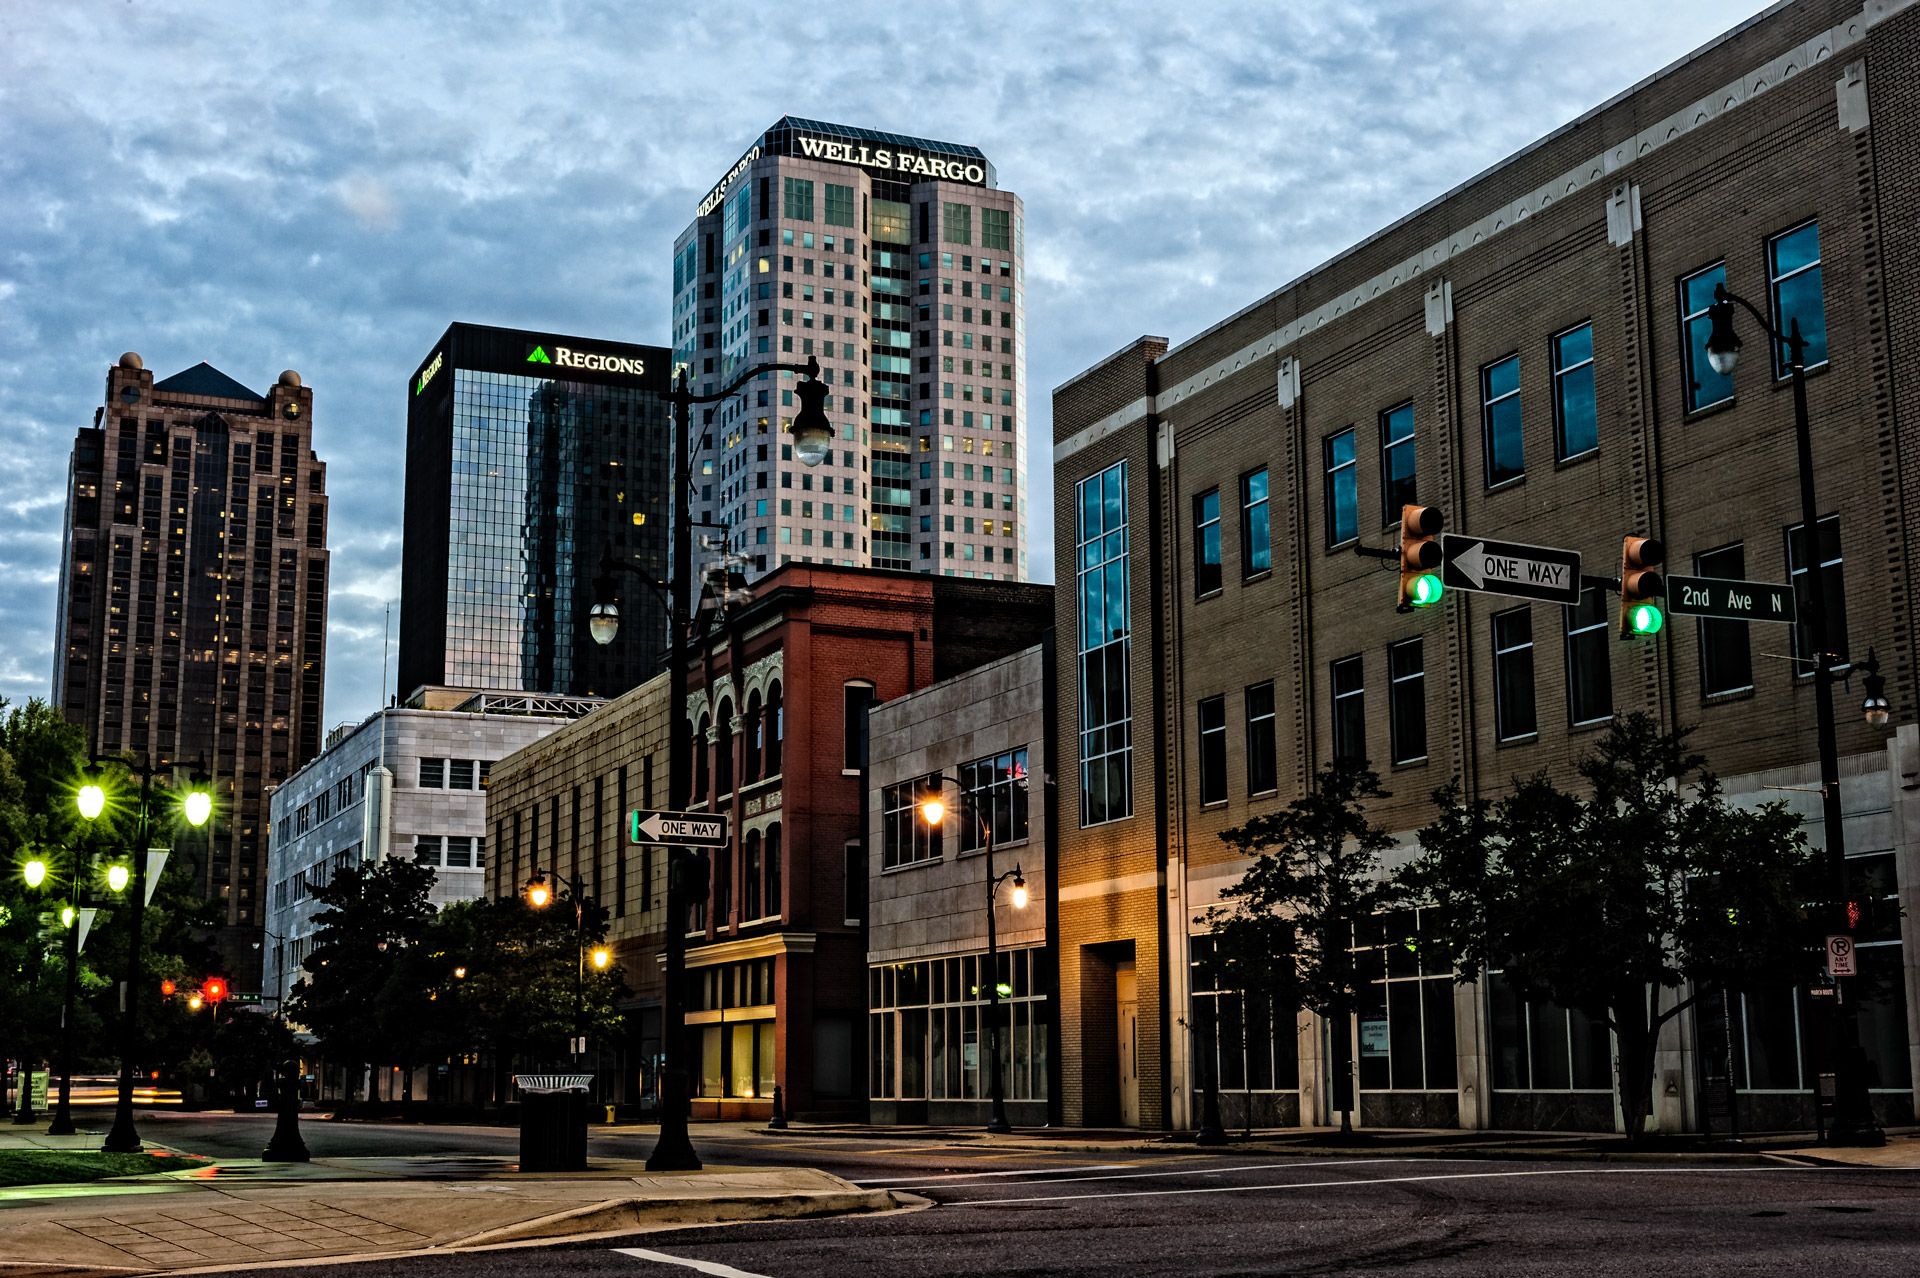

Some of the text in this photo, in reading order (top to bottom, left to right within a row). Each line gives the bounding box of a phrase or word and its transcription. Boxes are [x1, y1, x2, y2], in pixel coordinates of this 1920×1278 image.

[798, 137, 984, 183] WELLS FARGO
[555, 347, 644, 375] REGIONS
[1484, 557, 1563, 585] ONE WAY
[1682, 586, 1781, 612] 2nd Ave N
[661, 821, 717, 836] ONE WAY
